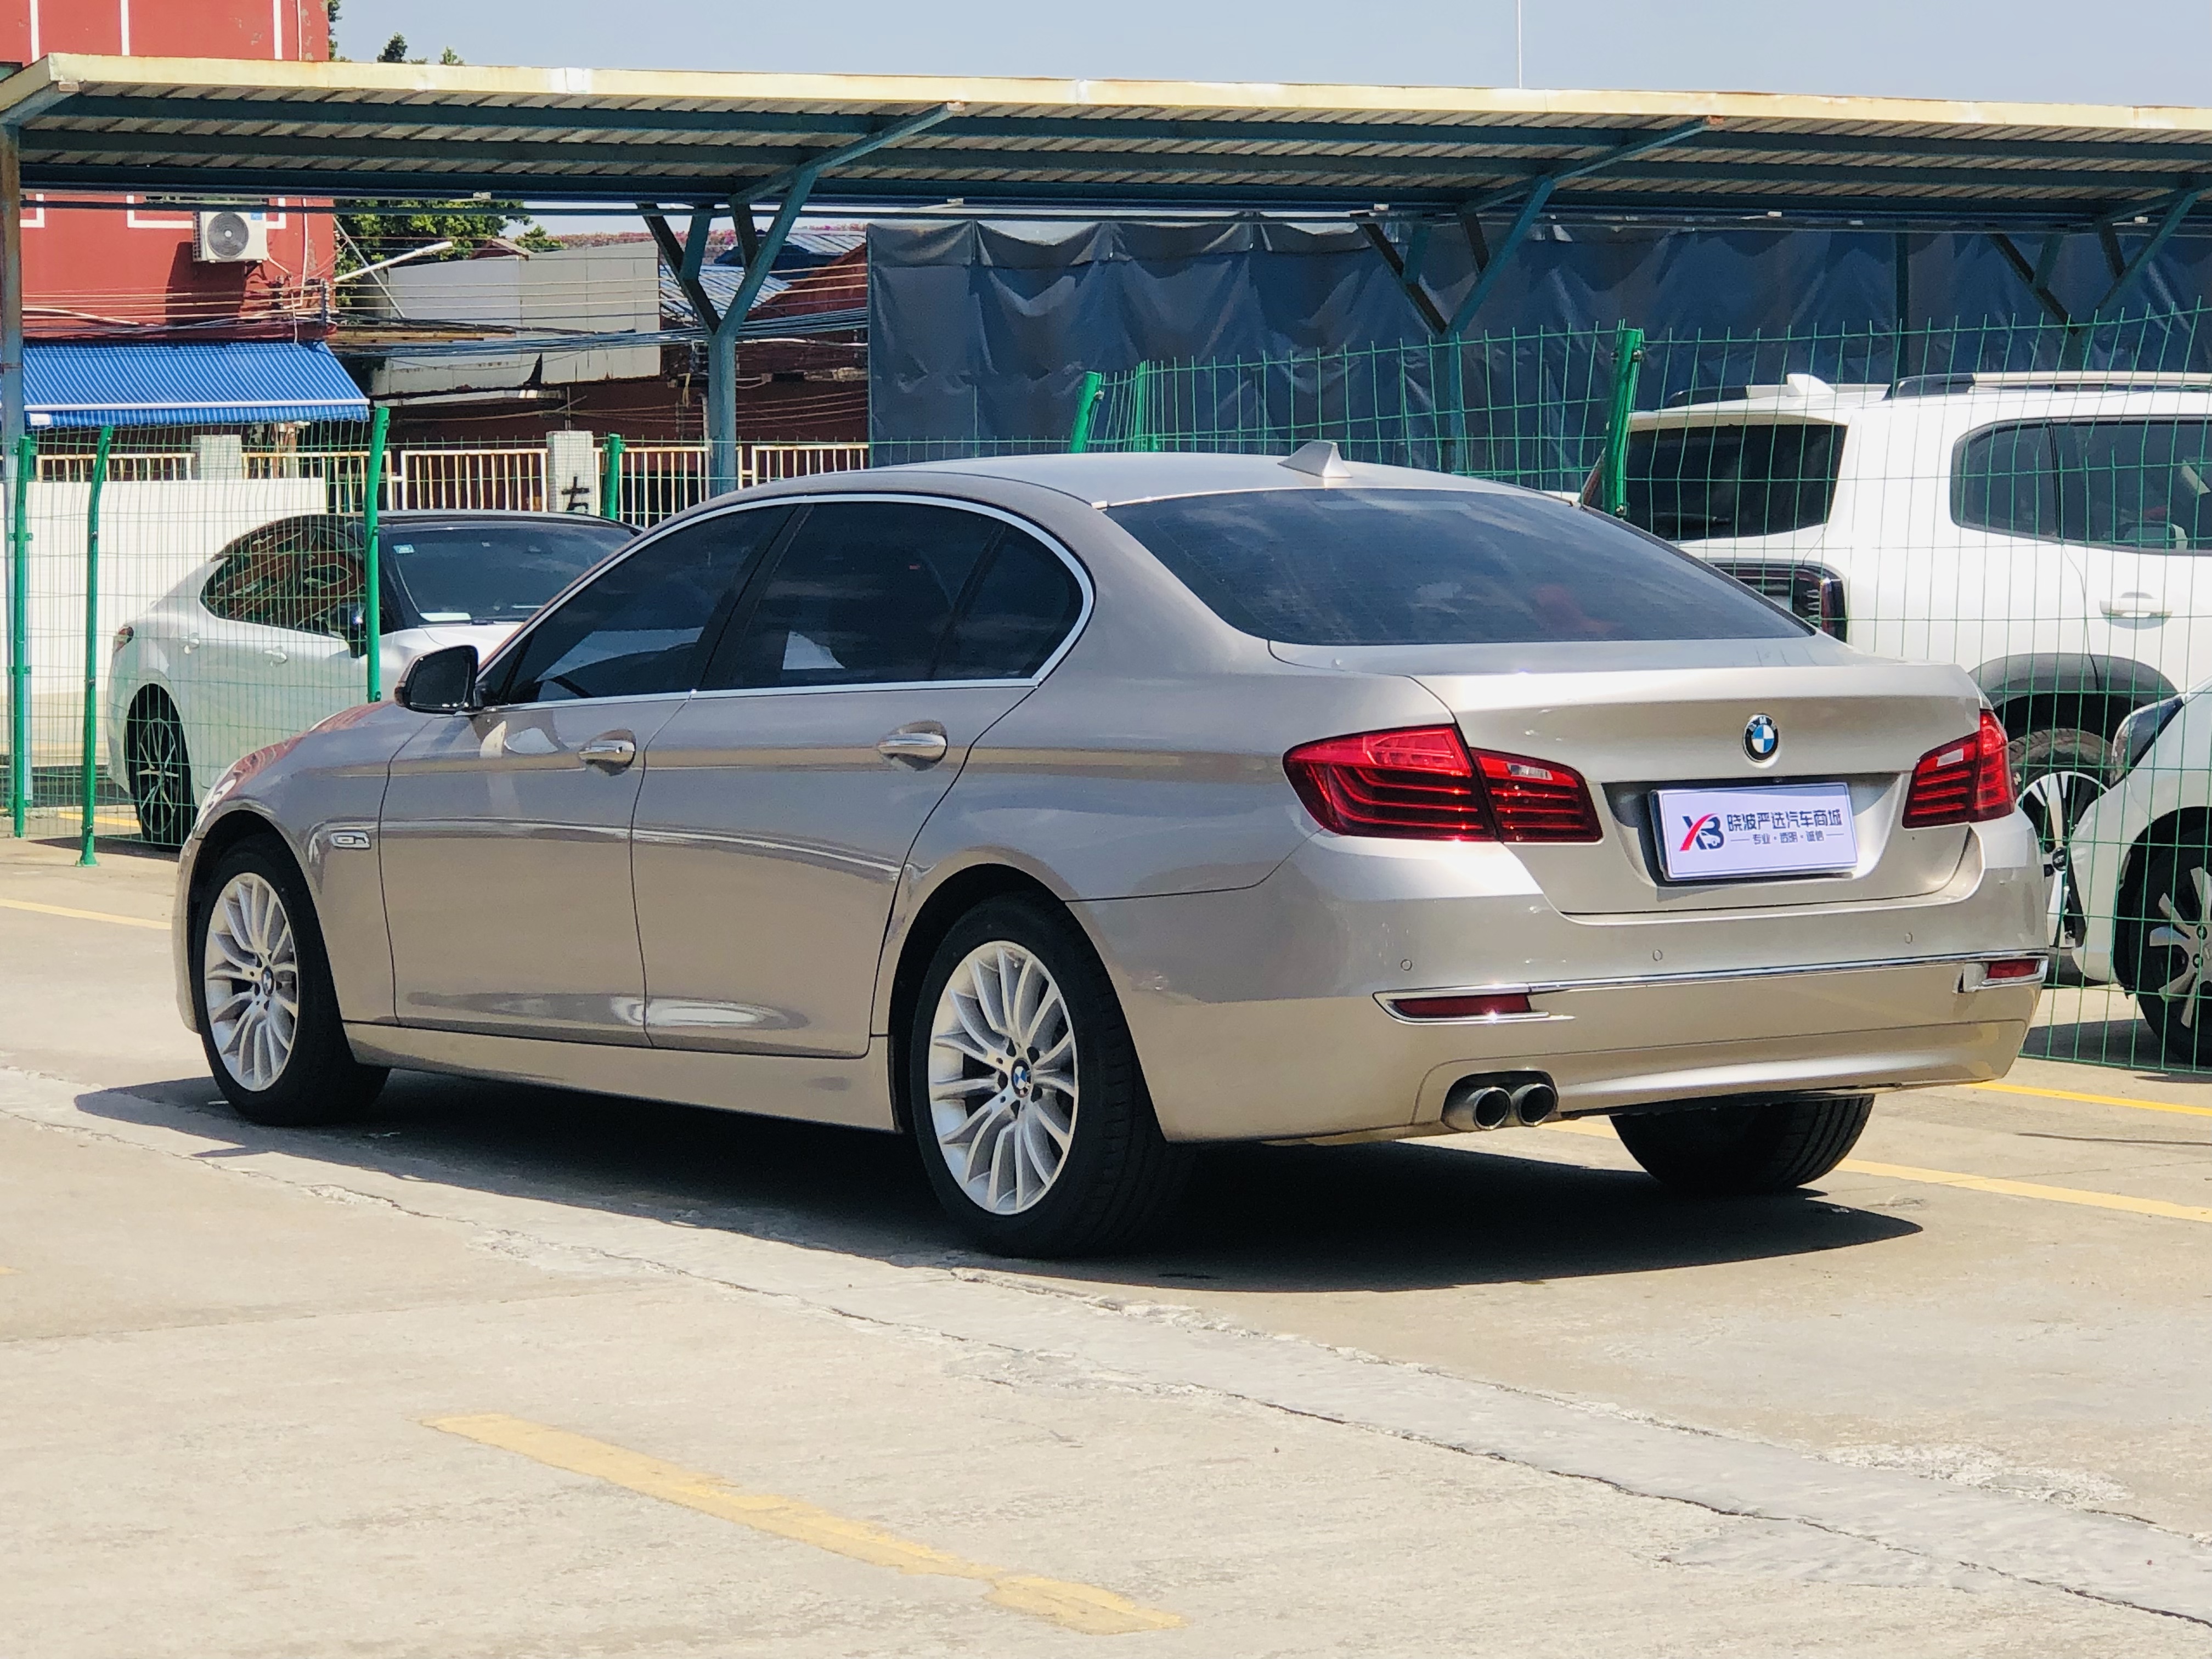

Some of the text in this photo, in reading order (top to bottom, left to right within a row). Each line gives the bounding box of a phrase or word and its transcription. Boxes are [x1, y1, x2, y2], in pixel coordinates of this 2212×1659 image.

[1748, 716, 1777, 732] BMW
[1726, 809, 1842, 831] 晓波严选汽车商城
